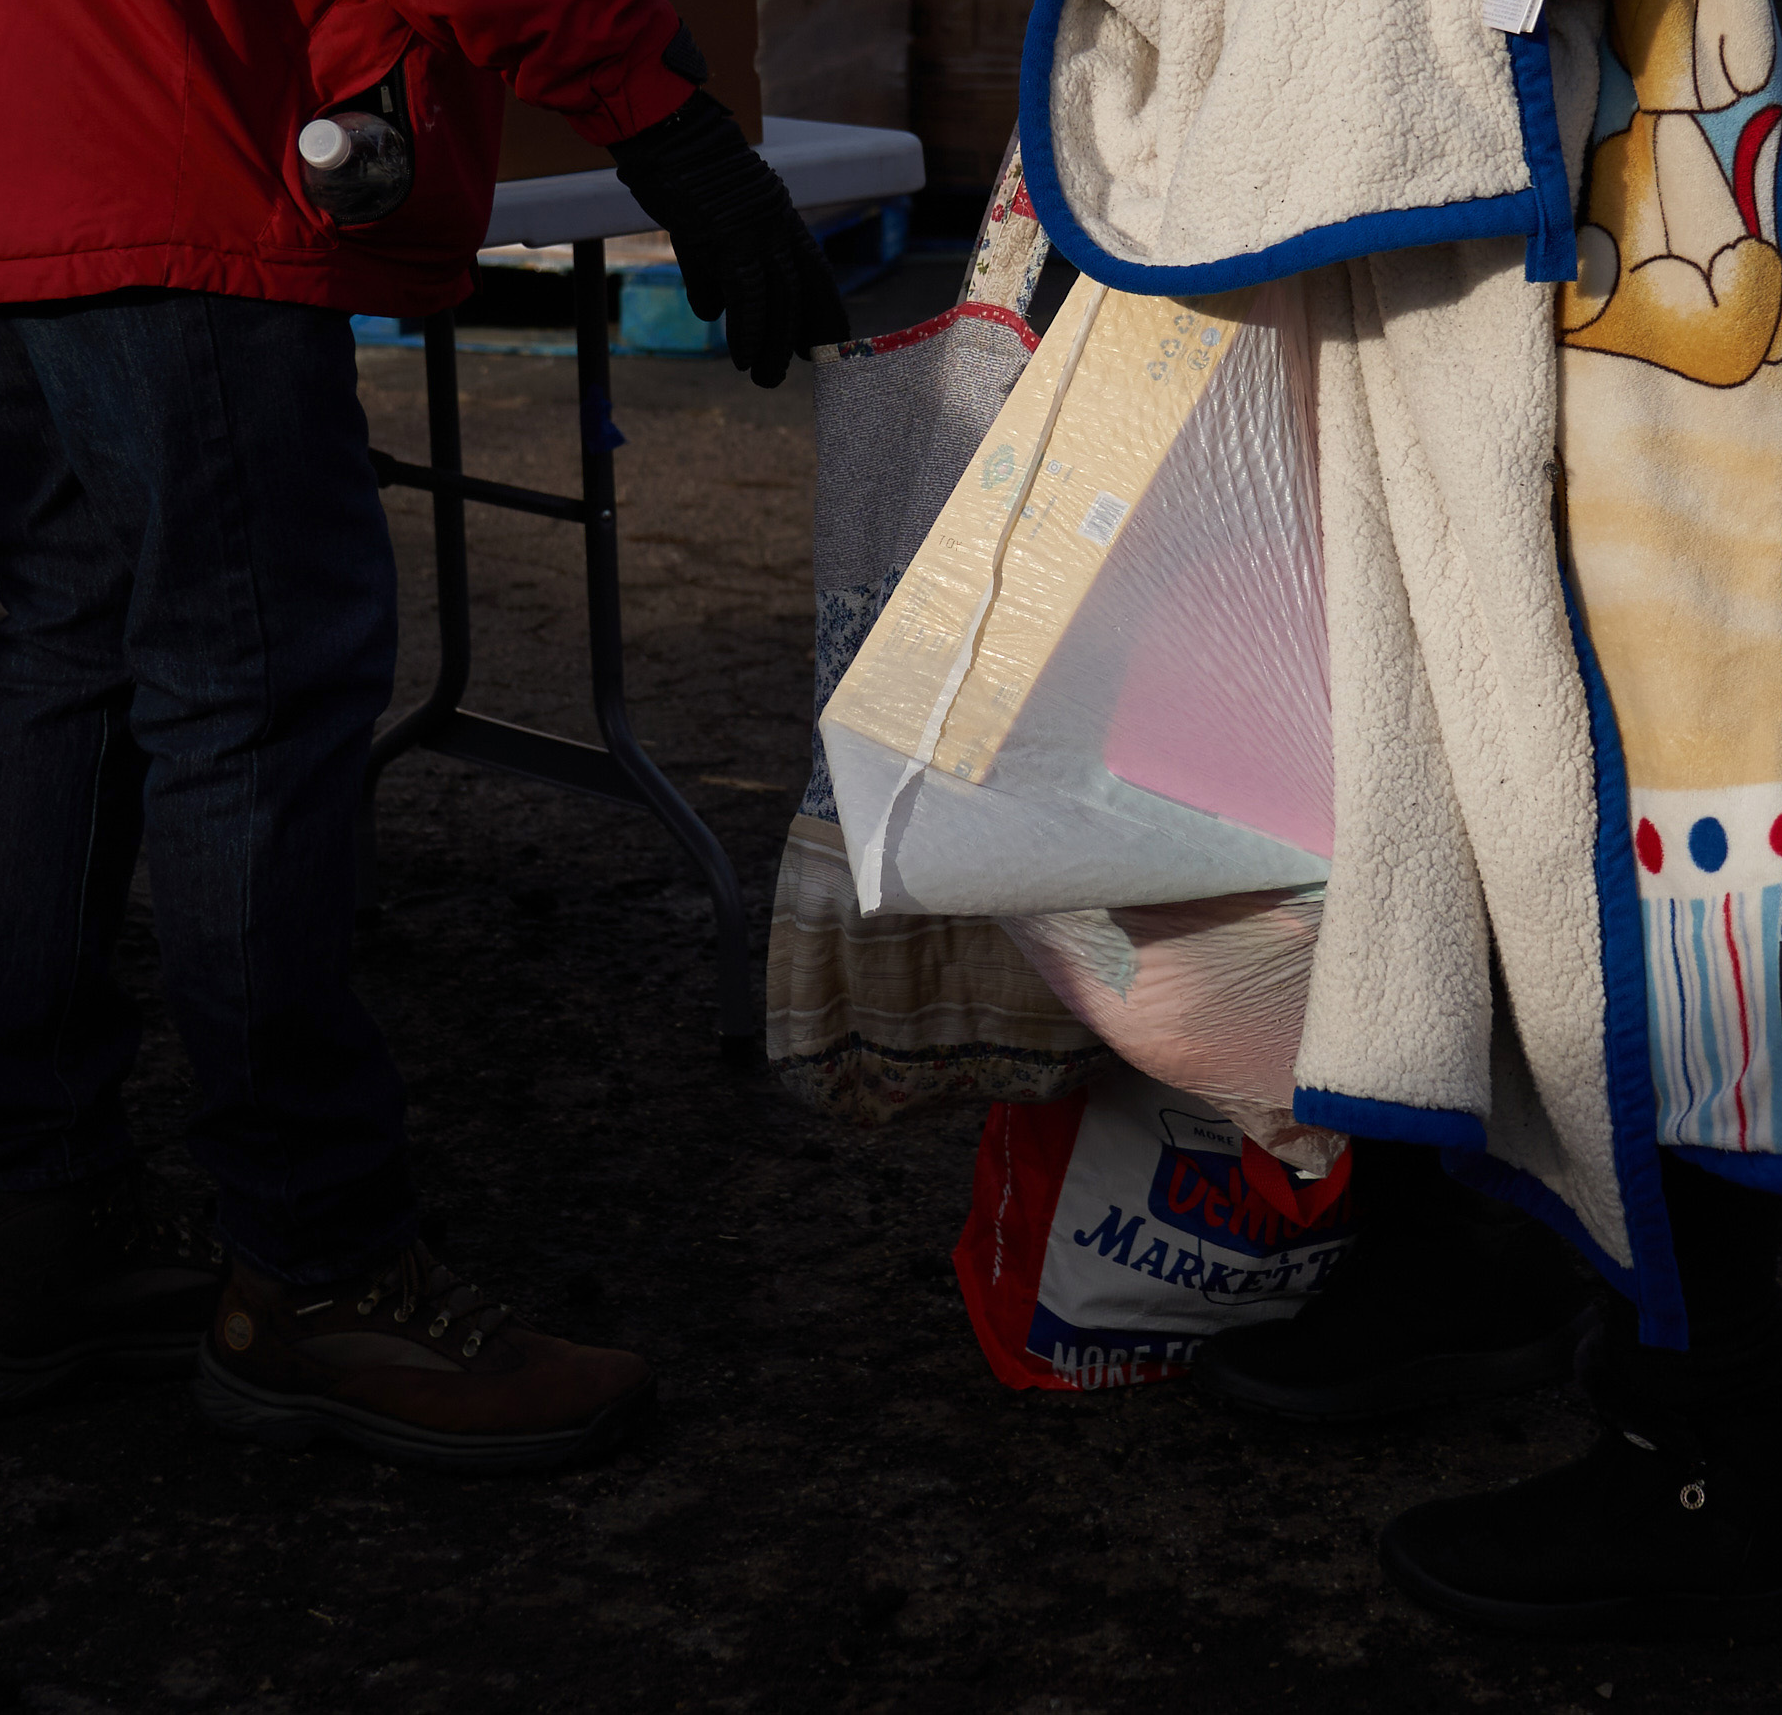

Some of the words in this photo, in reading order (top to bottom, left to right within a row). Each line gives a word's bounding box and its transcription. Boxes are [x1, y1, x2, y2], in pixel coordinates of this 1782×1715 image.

[1193, 1127, 1235, 1146] MORE
[1074, 1205, 1303, 1294] MARKET
[1052, 1341, 1151, 1390] MORE
